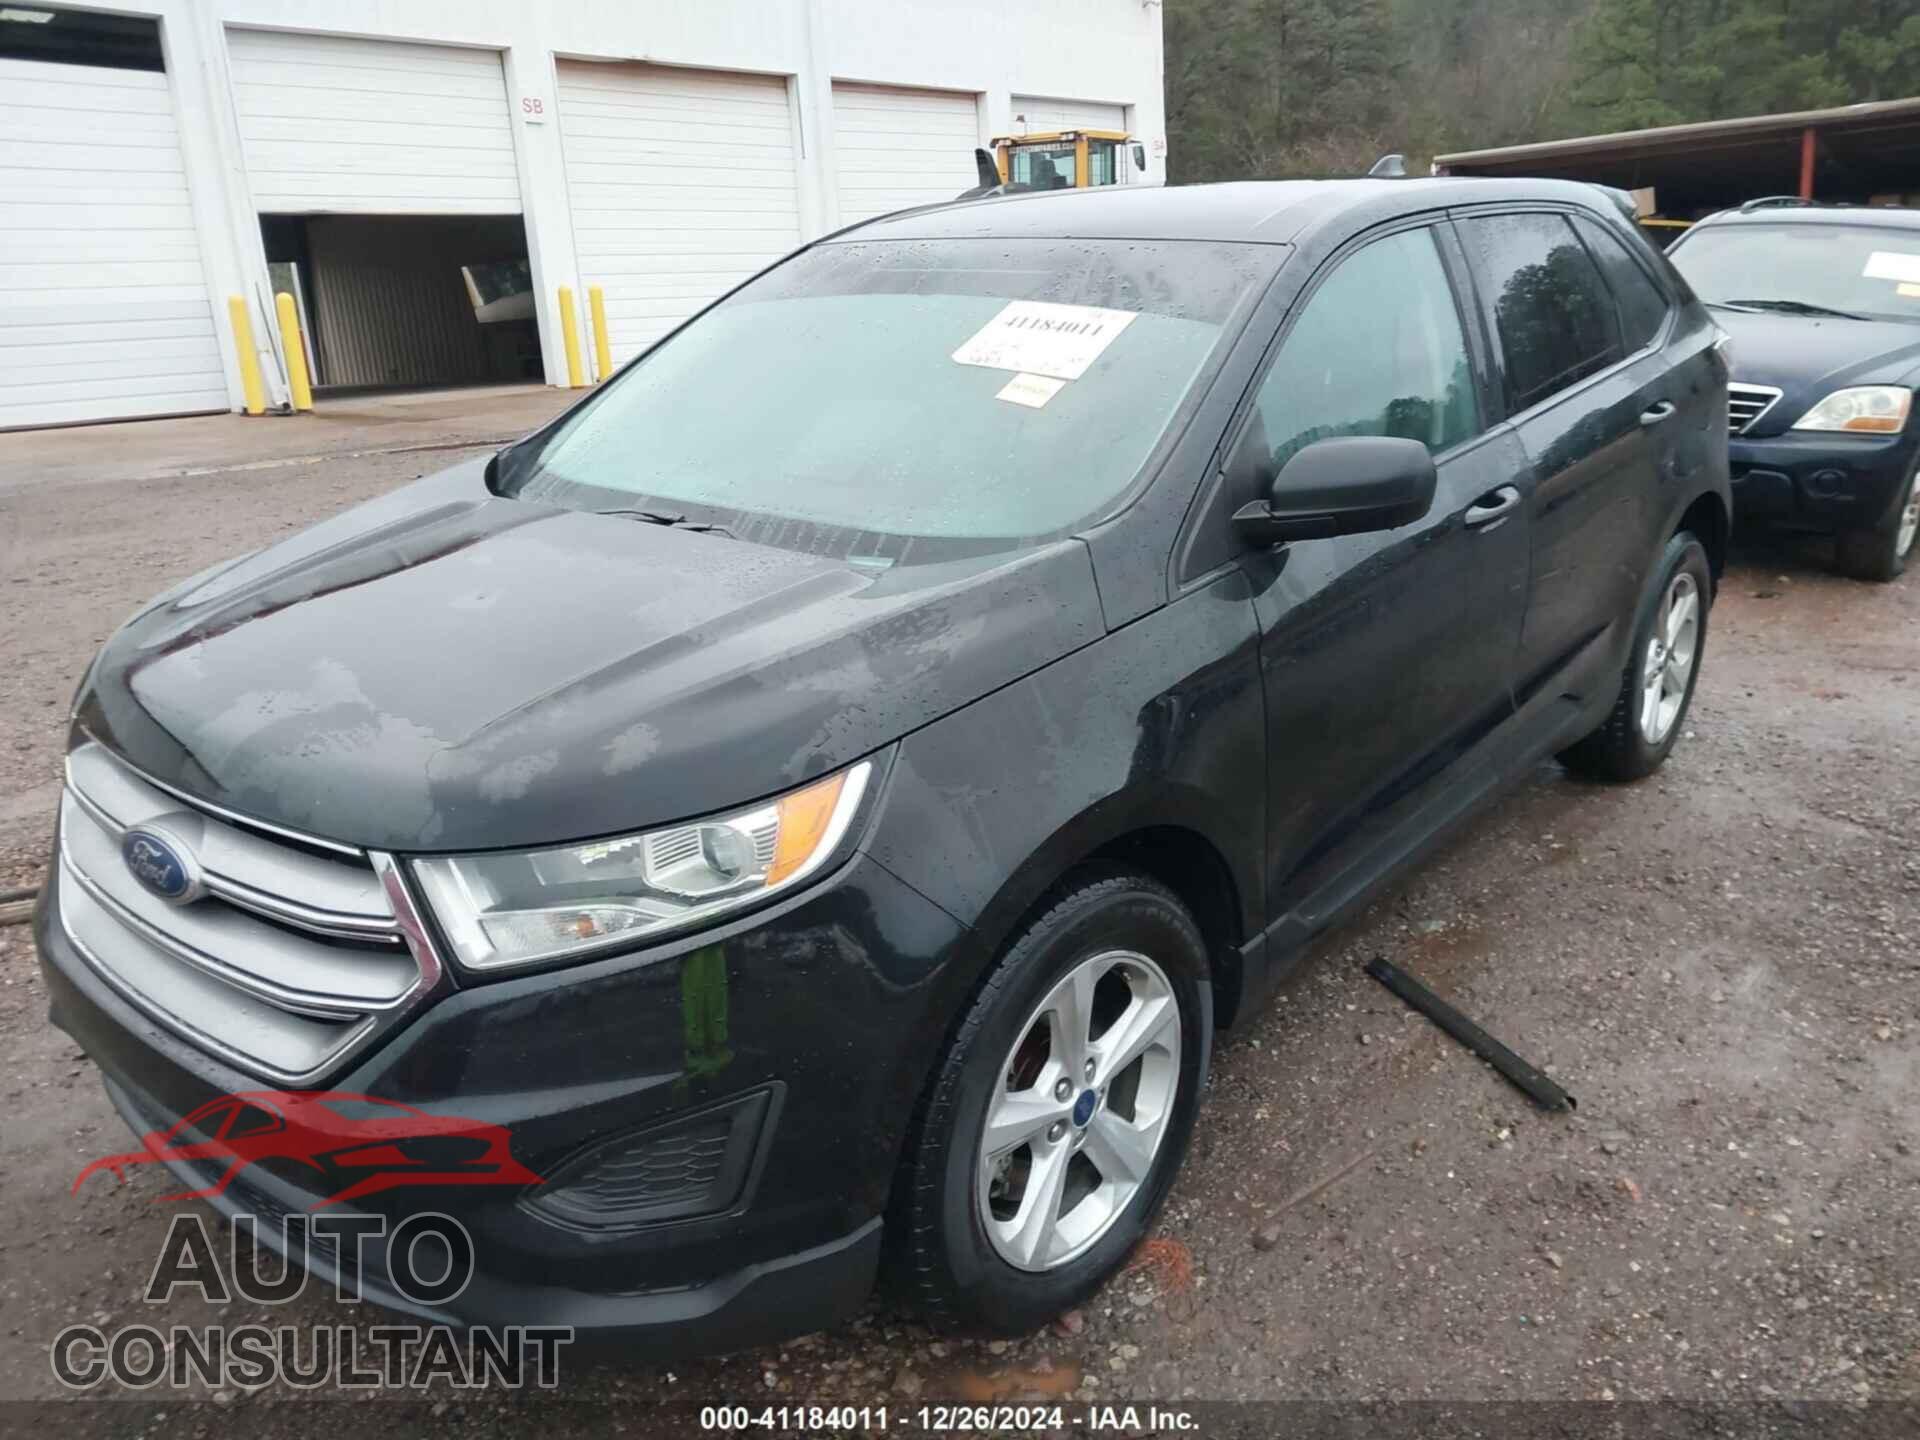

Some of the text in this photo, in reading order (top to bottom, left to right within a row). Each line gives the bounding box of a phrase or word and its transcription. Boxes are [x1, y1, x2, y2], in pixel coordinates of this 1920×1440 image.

[522, 98, 544, 114] SB
[1006, 316, 1104, 337] 41184011
[129, 840, 172, 888] Ford
